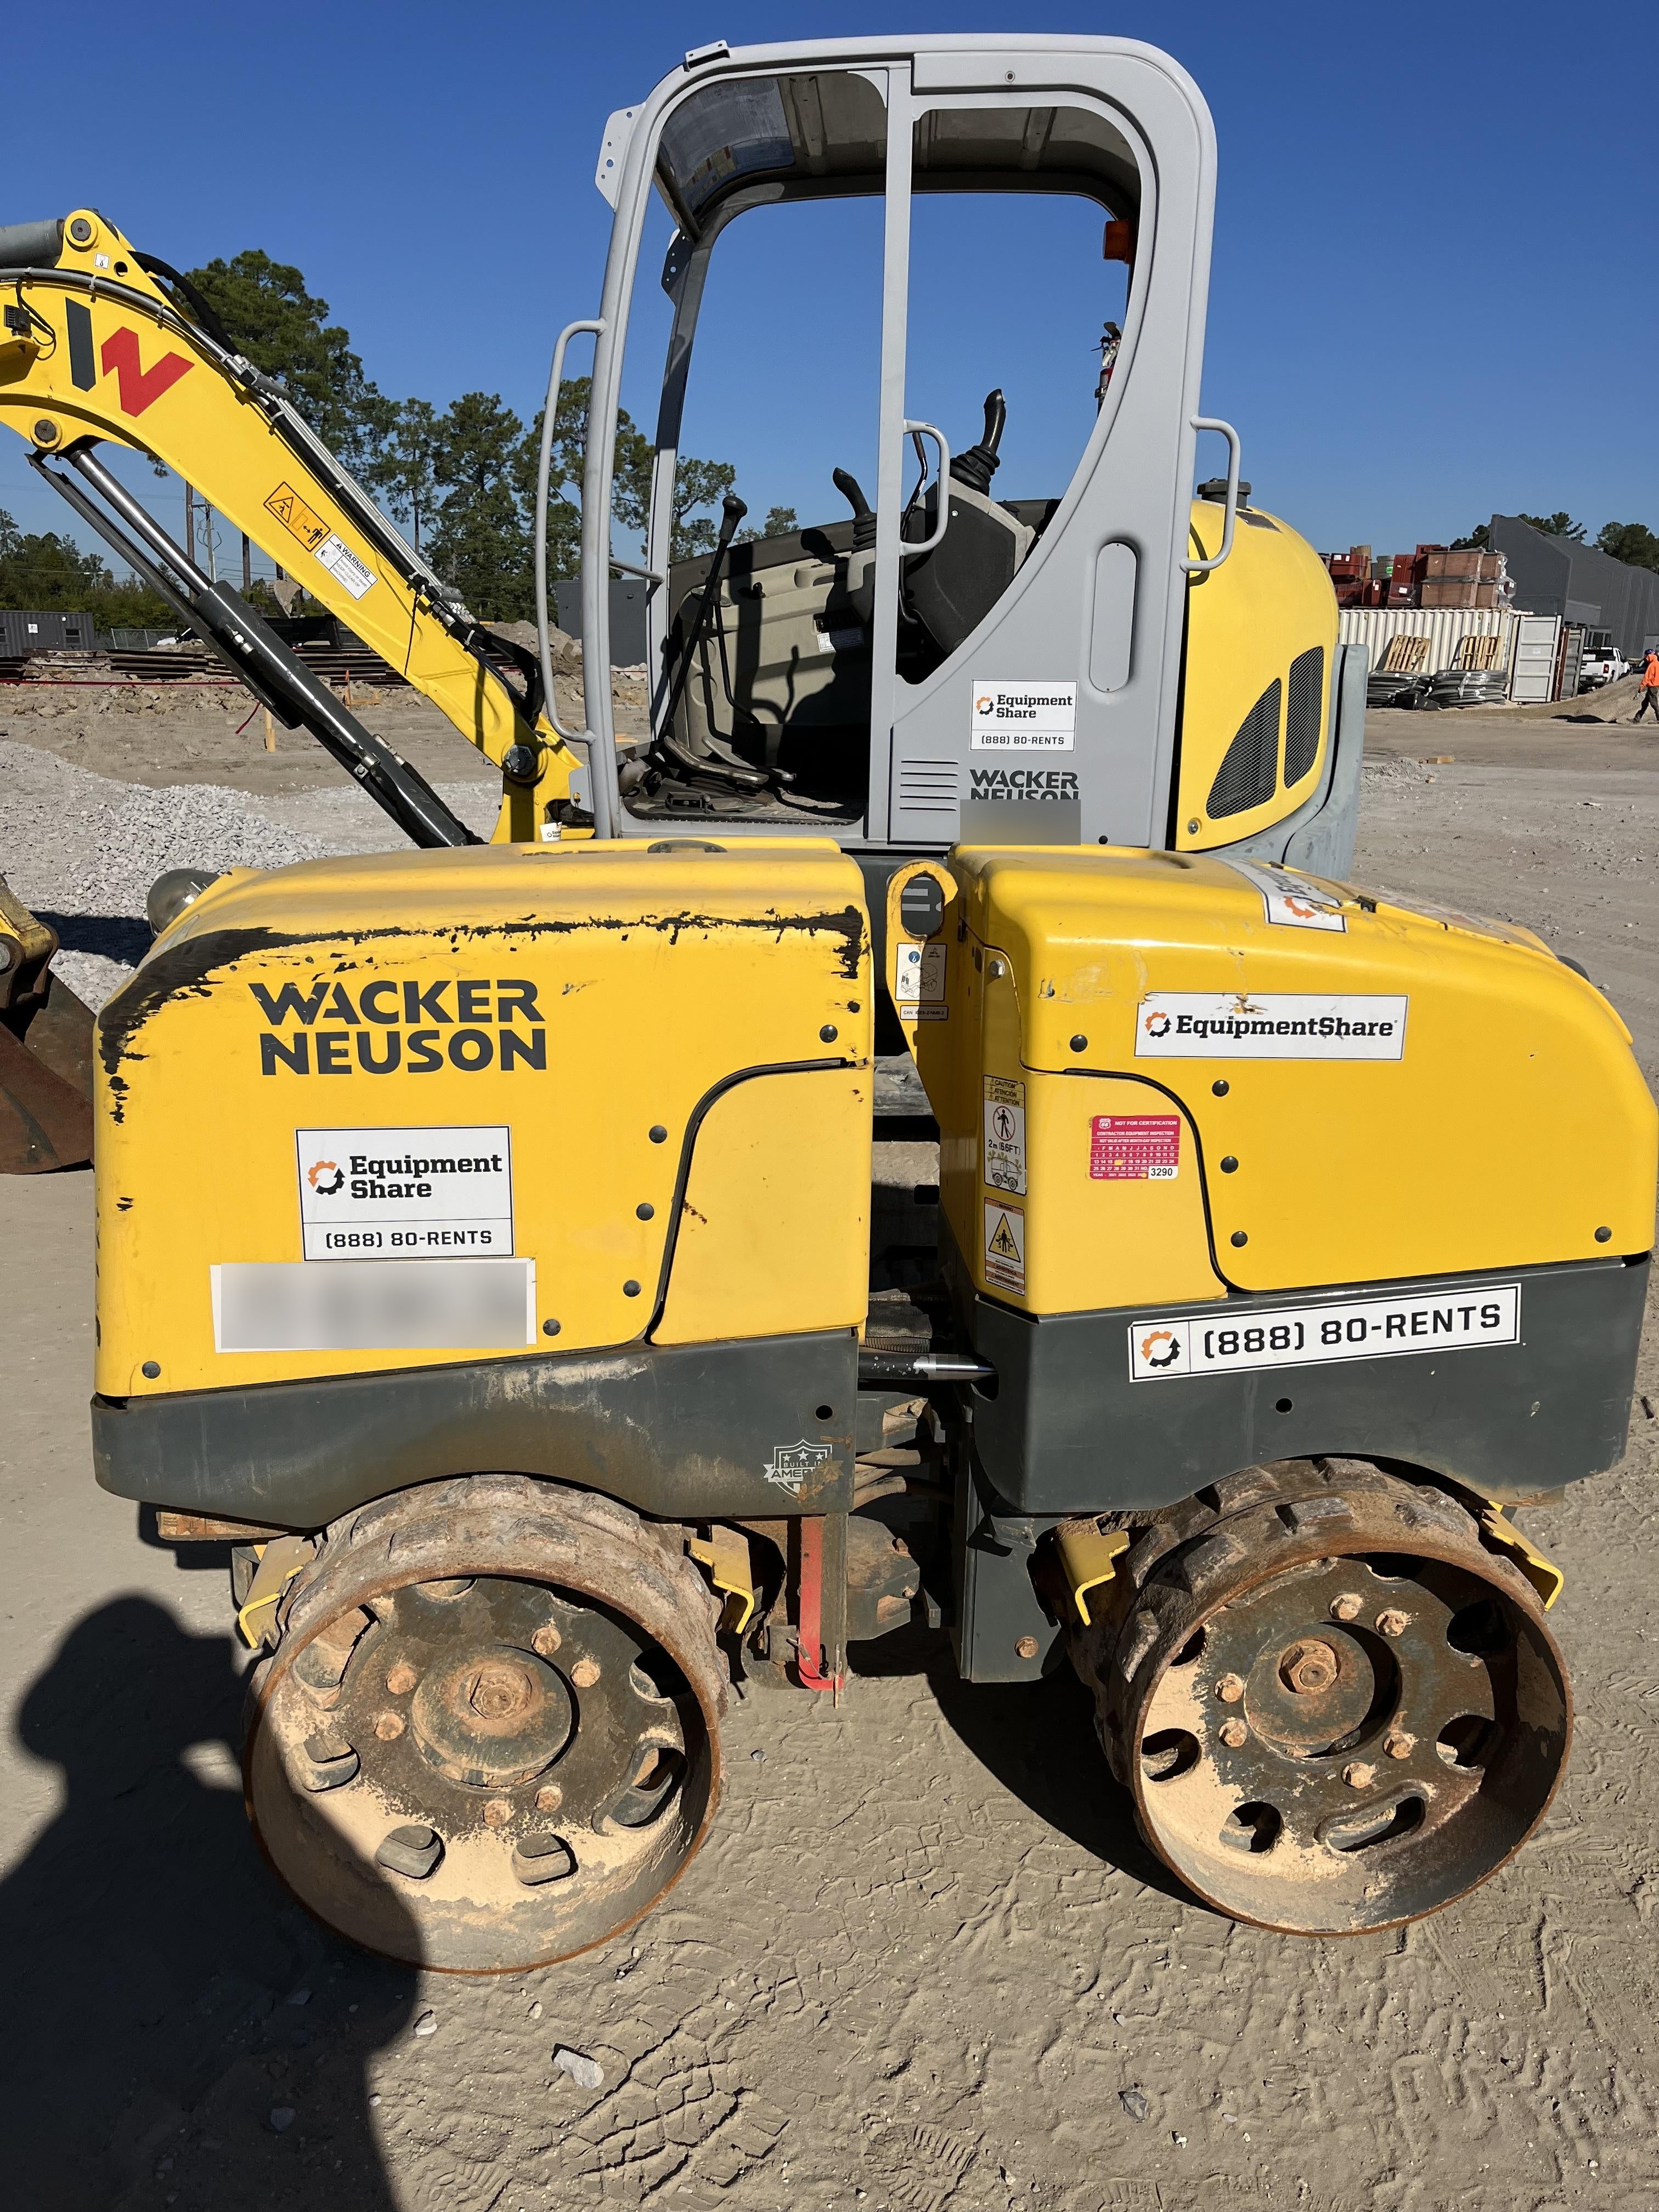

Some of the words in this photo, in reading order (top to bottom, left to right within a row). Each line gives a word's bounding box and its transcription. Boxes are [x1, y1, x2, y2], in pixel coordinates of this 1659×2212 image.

[342, 547, 370, 578] WARNING
[996, 695, 1073, 707] Equipment
[996, 707, 1036, 718] Share
[981, 735, 1009, 745] (888)
[1014, 736, 1064, 745] 80-RENTS
[969, 769, 1079, 789] WACKER
[248, 979, 546, 1025] WACKER
[1176, 1014, 1393, 1039] EquipmentShare
[259, 1028, 547, 1075] NEUSON
[995, 1080, 1015, 1089] CAUTION
[994, 1096, 1020, 1106] ATTENTION
[349, 1154, 503, 1178] Equipment
[351, 1180, 432, 1199] Share
[326, 1232, 382, 1249] (888)
[391, 1230, 493, 1246] 80-RENTS
[1204, 1322, 1304, 1359] (888)
[1321, 1304, 1501, 1345] 80-RENTS
